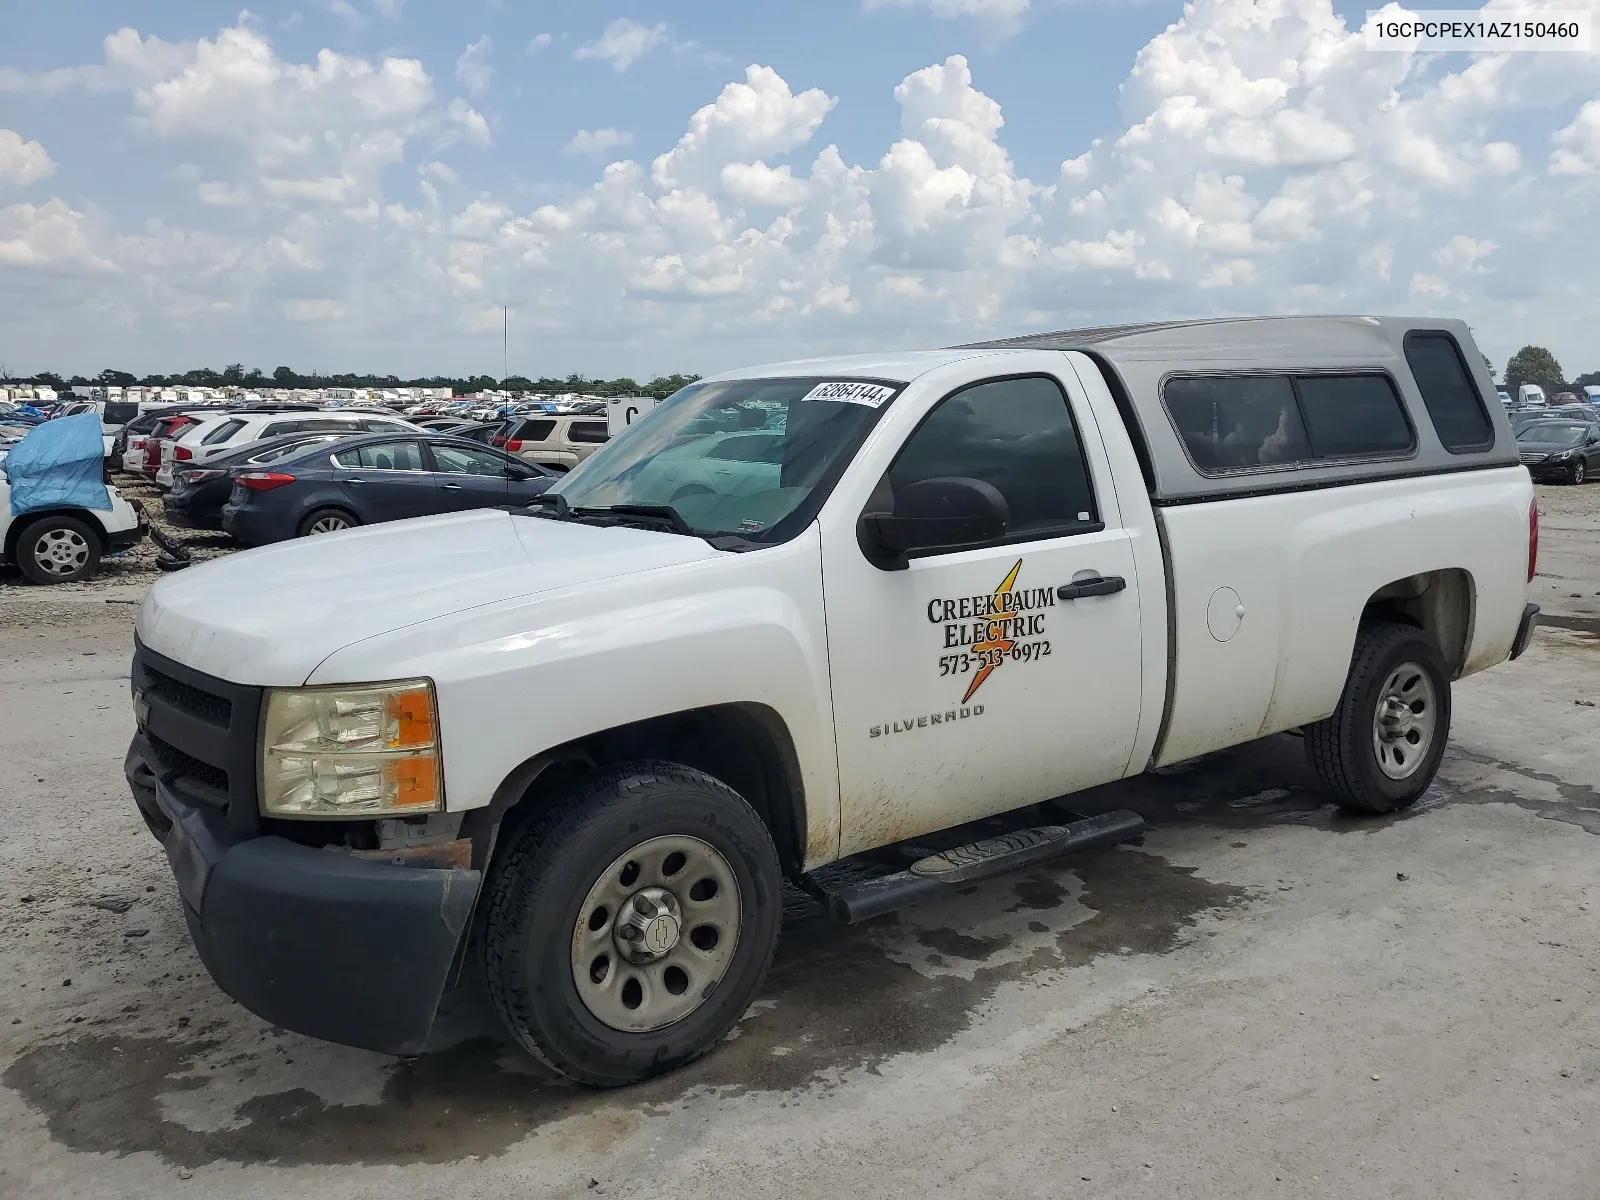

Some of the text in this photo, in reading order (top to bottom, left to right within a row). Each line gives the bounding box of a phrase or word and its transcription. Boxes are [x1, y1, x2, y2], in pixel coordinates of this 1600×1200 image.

[943, 613, 1045, 649] ELECTRIC
[938, 640, 1052, 677] 573-513-6972
[869, 704, 985, 738] SILVERADO
